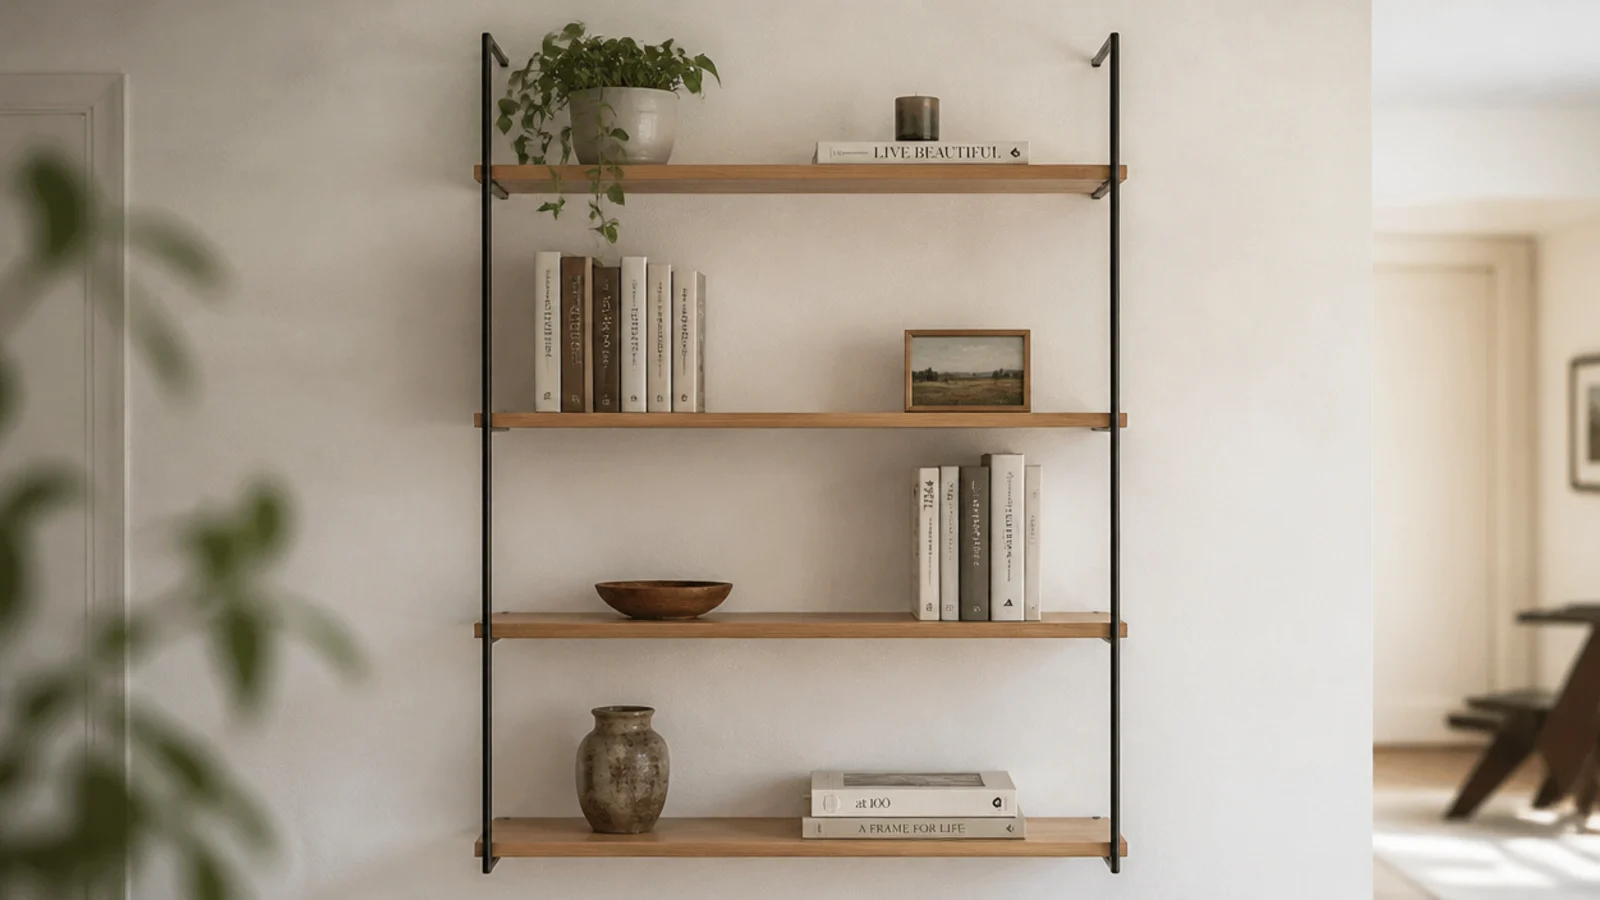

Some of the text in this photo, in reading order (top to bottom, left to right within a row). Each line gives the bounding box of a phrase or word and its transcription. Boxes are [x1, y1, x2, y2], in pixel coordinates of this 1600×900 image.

[874, 146, 911, 159] LIVE
[914, 146, 1002, 159] BEAUTIFUL
[855, 797, 891, 809] at 100
[858, 824, 966, 834] A FRAME FOR LIFE
